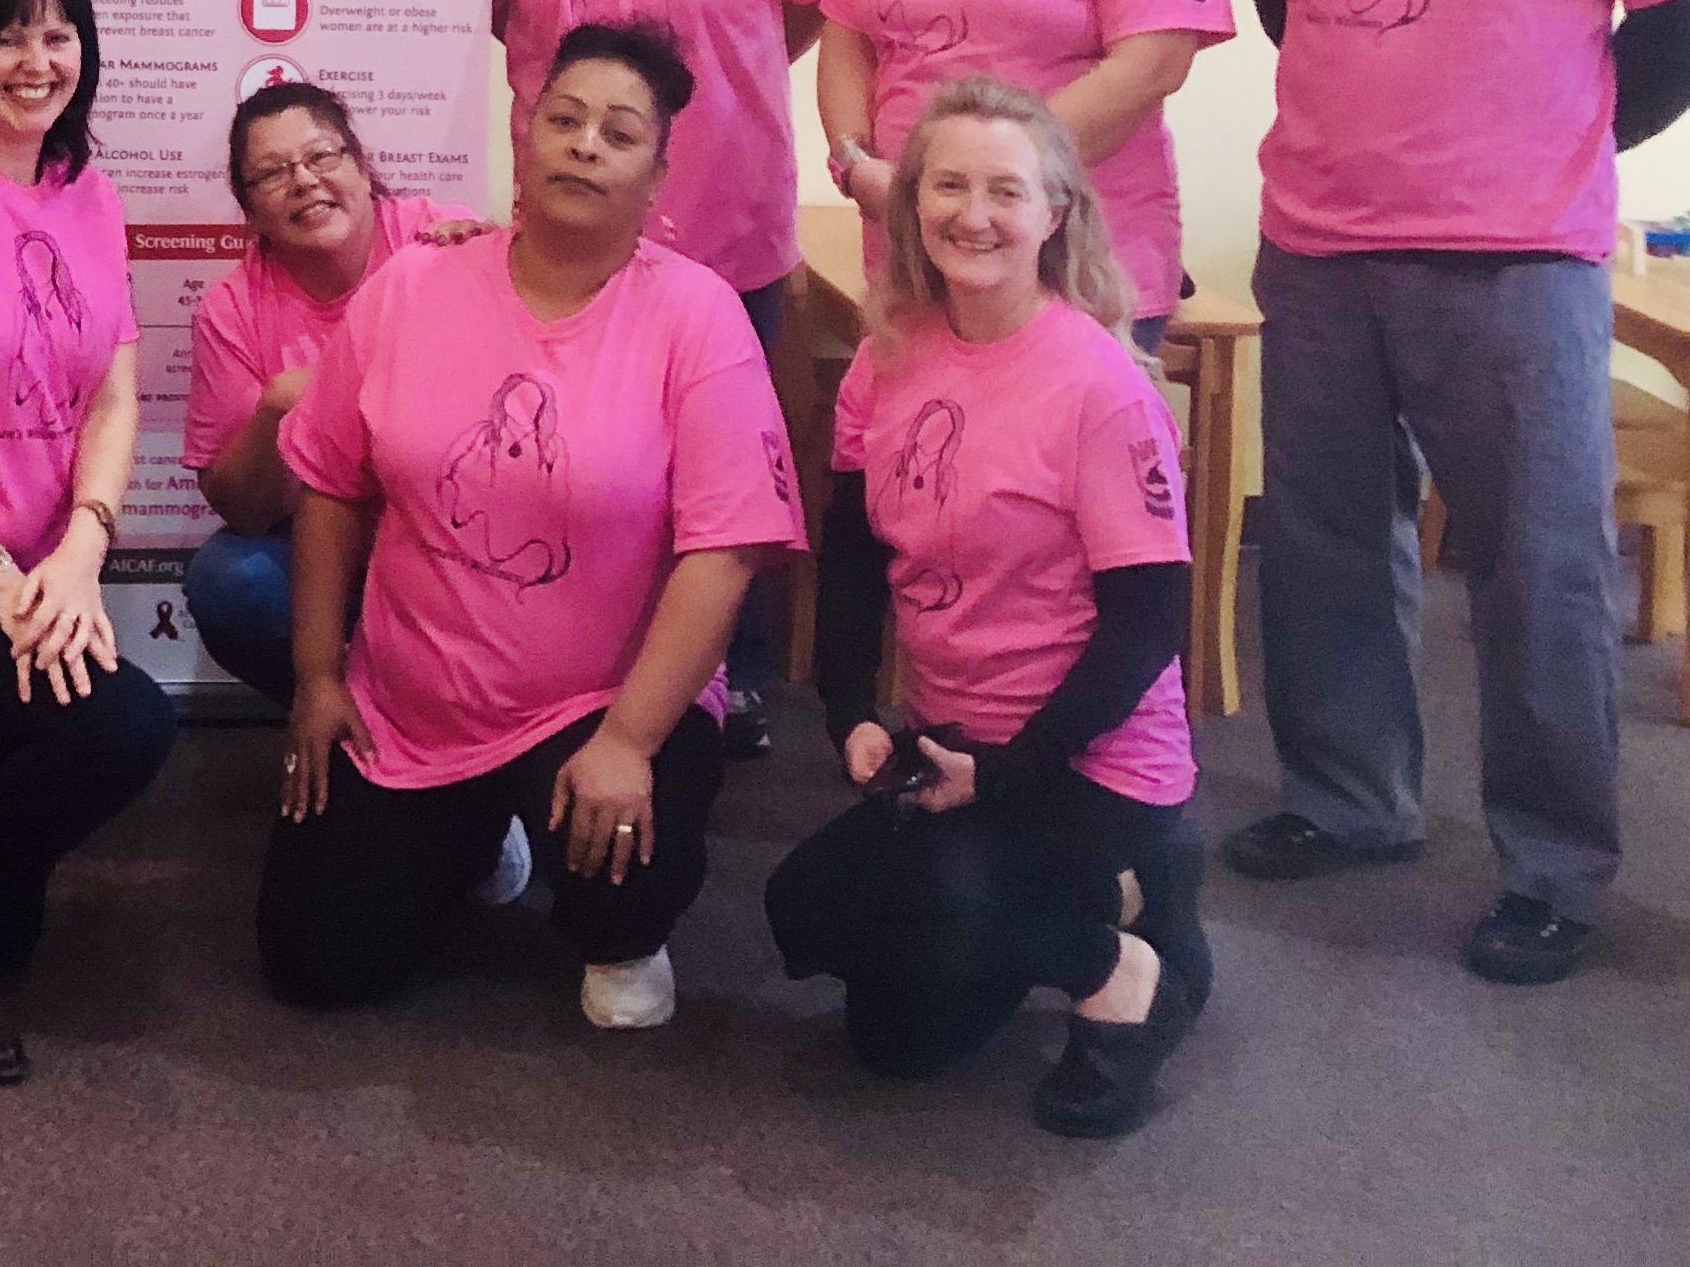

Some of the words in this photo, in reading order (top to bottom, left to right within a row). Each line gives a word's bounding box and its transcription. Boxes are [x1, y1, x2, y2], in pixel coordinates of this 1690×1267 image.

[112, 11, 166, 23] exposure
[167, 11, 190, 22] that
[320, 5, 386, 19] Overweight
[388, 7, 402, 17] or
[404, 6, 437, 18] obese
[98, 26, 136, 37] revent
[141, 26, 175, 37] breast
[178, 28, 216, 37] cancer
[319, 22, 362, 32] women
[365, 23, 384, 32] are
[387, 23, 398, 32] at
[402, 24, 408, 33] a
[412, 23, 449, 36] higher
[452, 23, 474, 34] risk
[129, 78, 167, 90] should
[171, 78, 197, 90] have
[121, 94, 134, 104] to
[137, 93, 164, 105] have
[166, 95, 173, 104] a
[378, 90, 384, 101] 3
[139, 111, 166, 120] once
[170, 112, 176, 120] a
[180, 111, 204, 123] year
[381, 106, 407, 118] your
[410, 105, 431, 116] risk
[126, 169, 172, 179] increase
[399, 170, 436, 181] health
[439, 172, 463, 181] care
[169, 183, 189, 194] risk
[135, 233, 216, 254] Screening
[183, 279, 205, 292] Age
[146, 478, 163, 490] for
